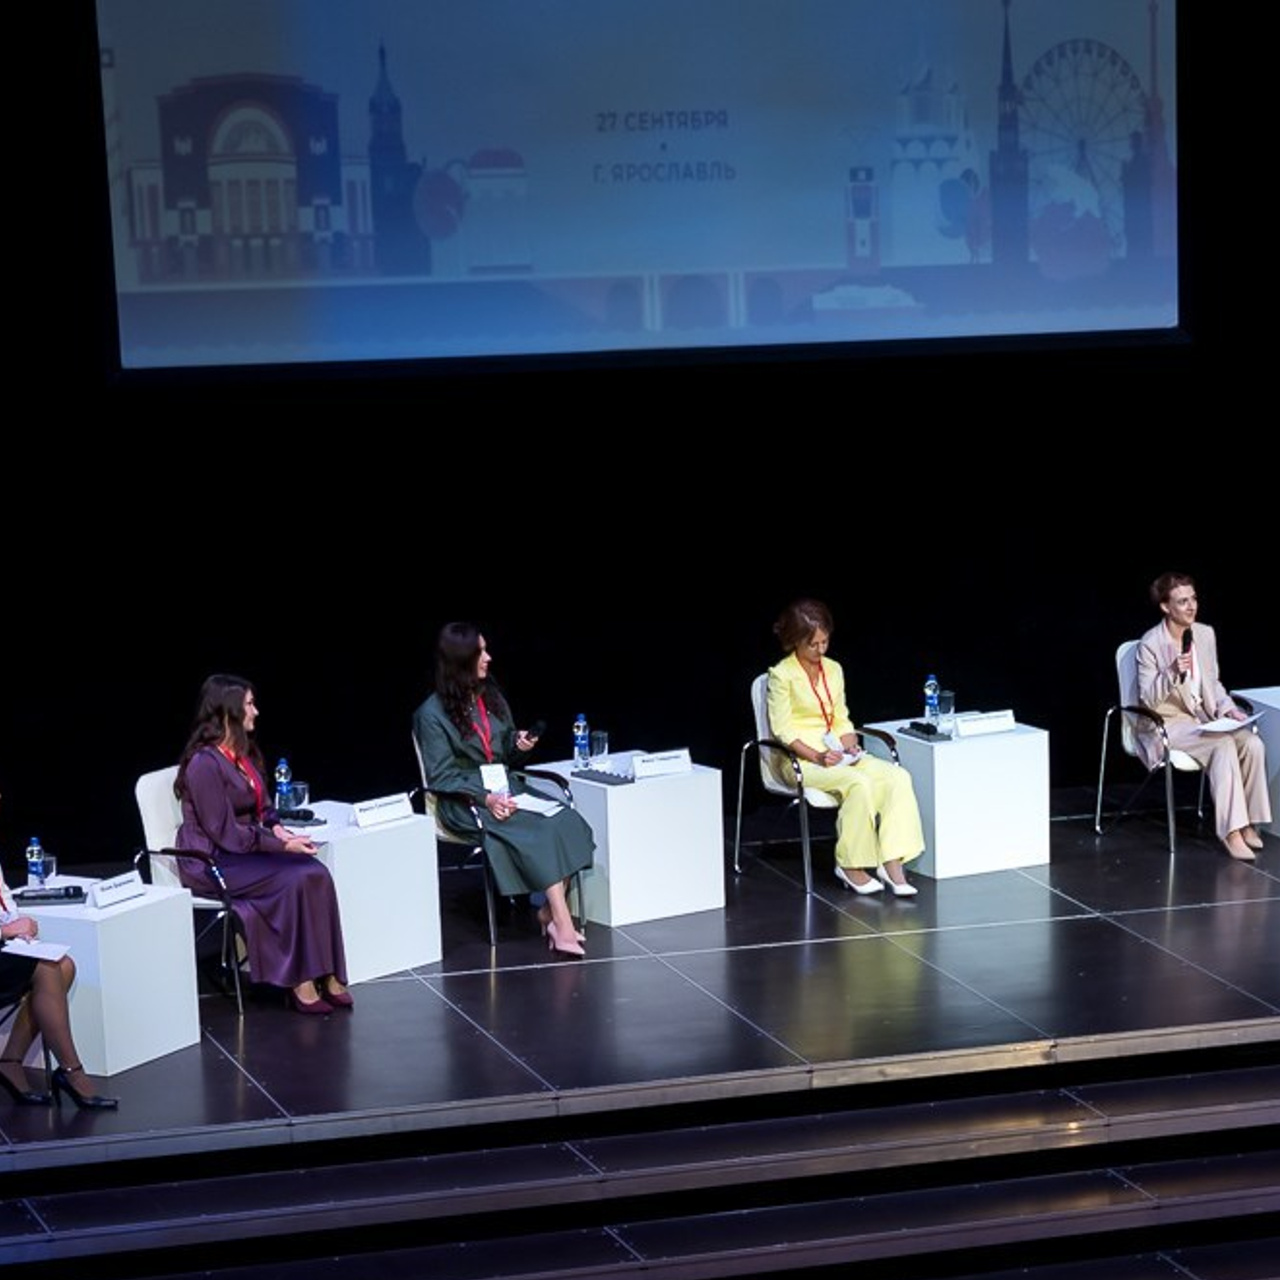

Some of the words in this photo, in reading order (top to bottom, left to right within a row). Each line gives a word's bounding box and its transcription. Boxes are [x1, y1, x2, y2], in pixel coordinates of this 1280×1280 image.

[596, 112, 617, 132] 27
[624, 110, 729, 132] СЕНТЯБРЯ
[593, 163, 606, 183] Г.
[611, 161, 737, 183] ЯРОСЛАВЛЬ
